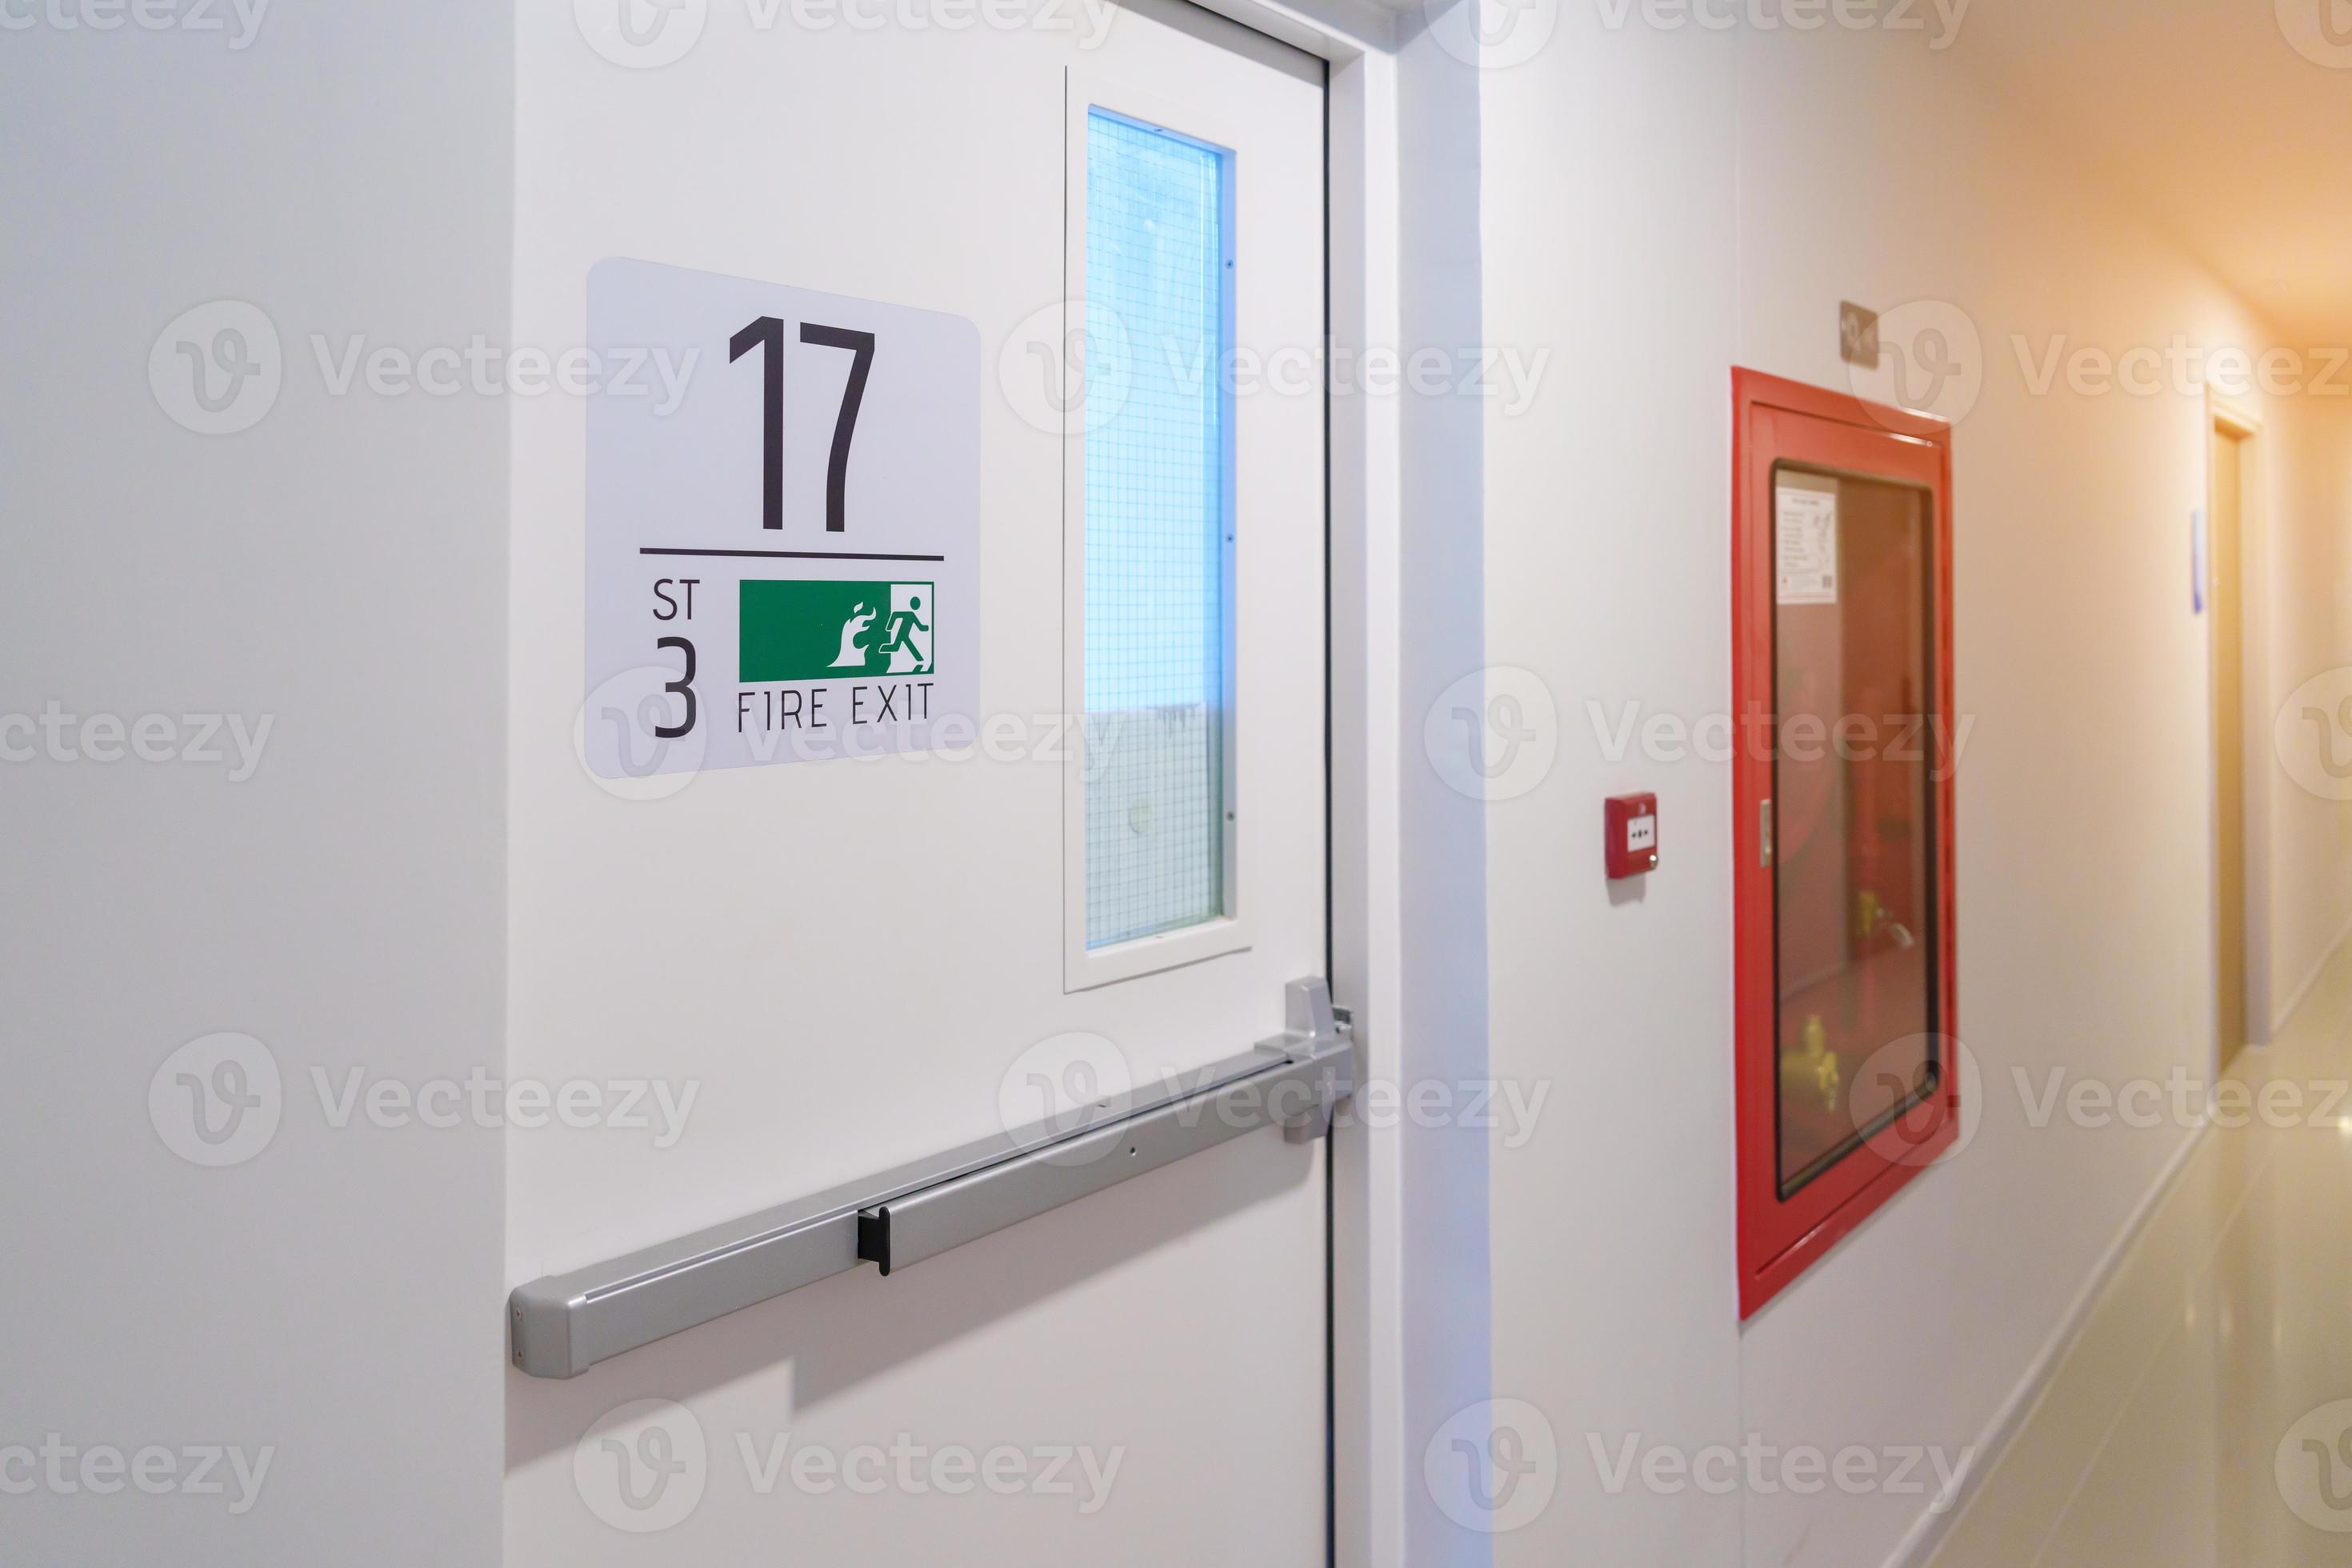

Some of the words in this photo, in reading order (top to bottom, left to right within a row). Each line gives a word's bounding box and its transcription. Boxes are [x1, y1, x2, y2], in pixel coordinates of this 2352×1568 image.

[729, 315, 875, 533] 17
[652, 578, 701, 621] ST
[654, 636, 697, 738] 3
[737, 687, 828, 733] FIRE
[851, 682, 934, 725] EXIT
